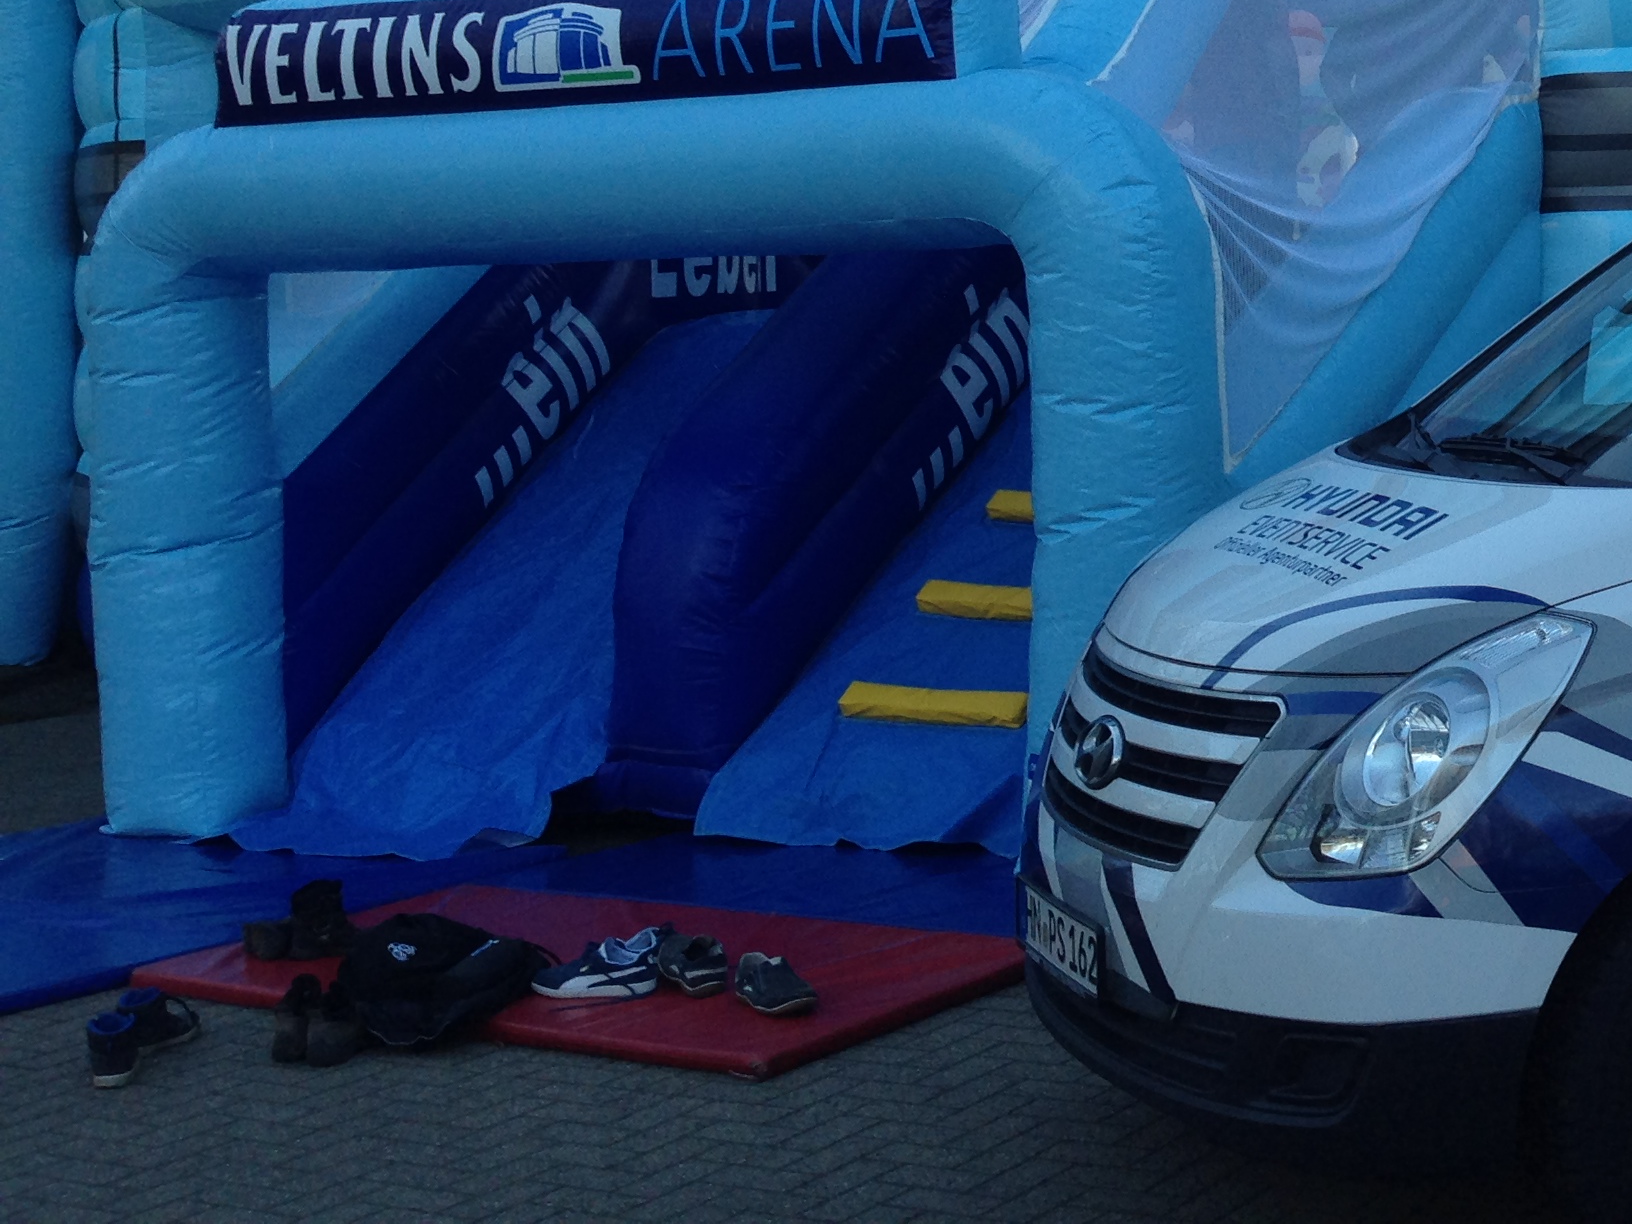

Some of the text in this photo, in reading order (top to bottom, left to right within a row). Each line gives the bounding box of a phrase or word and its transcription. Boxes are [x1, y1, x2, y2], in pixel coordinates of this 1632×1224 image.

[225, 11, 486, 107] VELTINS
[1281, 484, 1449, 541] HYUNDAI
[1236, 514, 1391, 571] EVENTSERVICE
[1258, 546, 1348, 587] Agenturpartner
